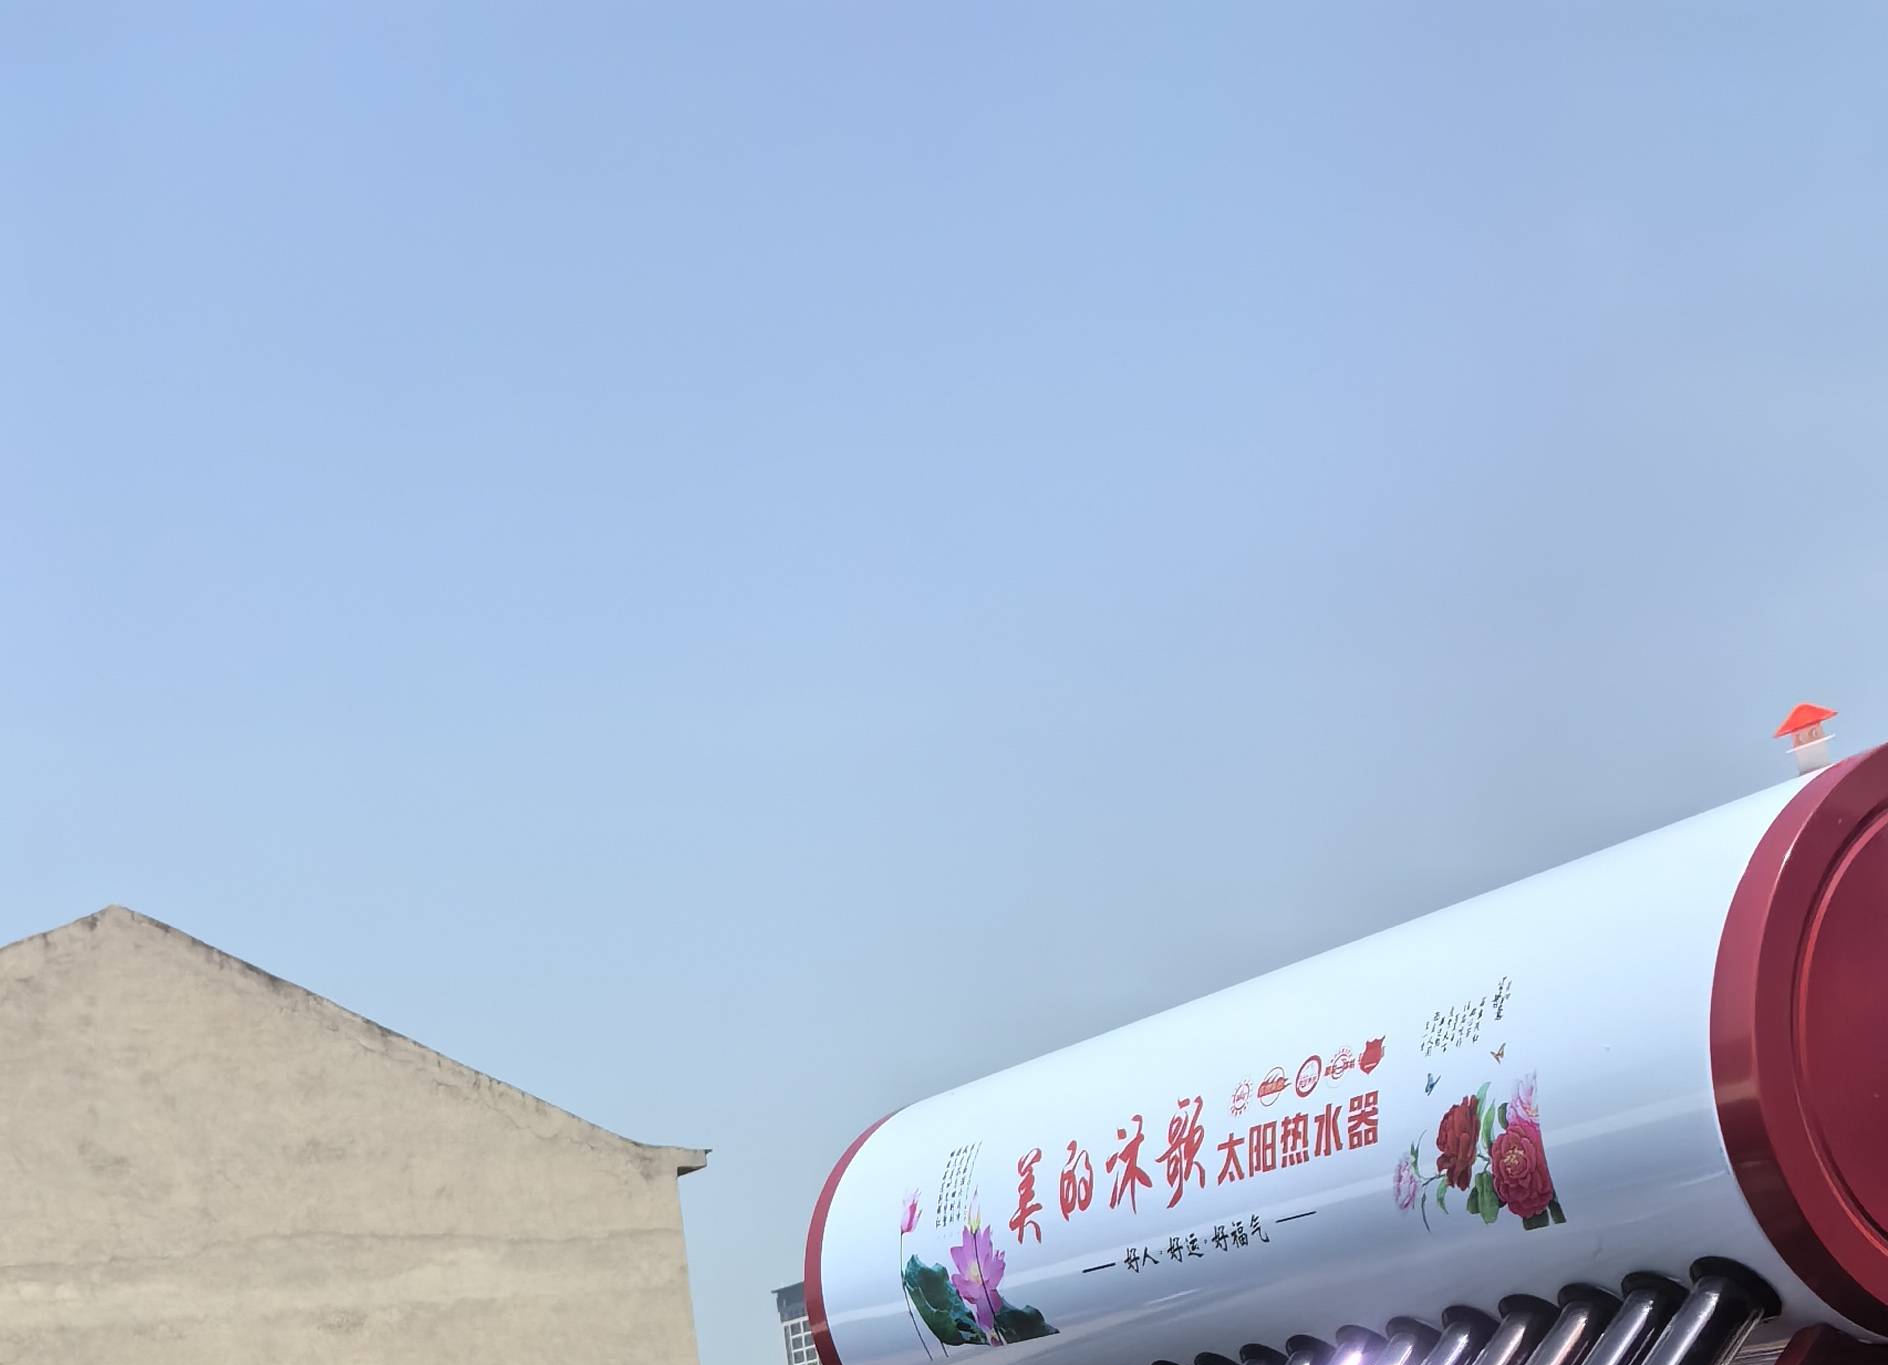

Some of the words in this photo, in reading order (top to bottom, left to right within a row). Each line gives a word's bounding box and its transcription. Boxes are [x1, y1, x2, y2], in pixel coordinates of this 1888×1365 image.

[1217, 1090, 1379, 1185] 太阳热水器
